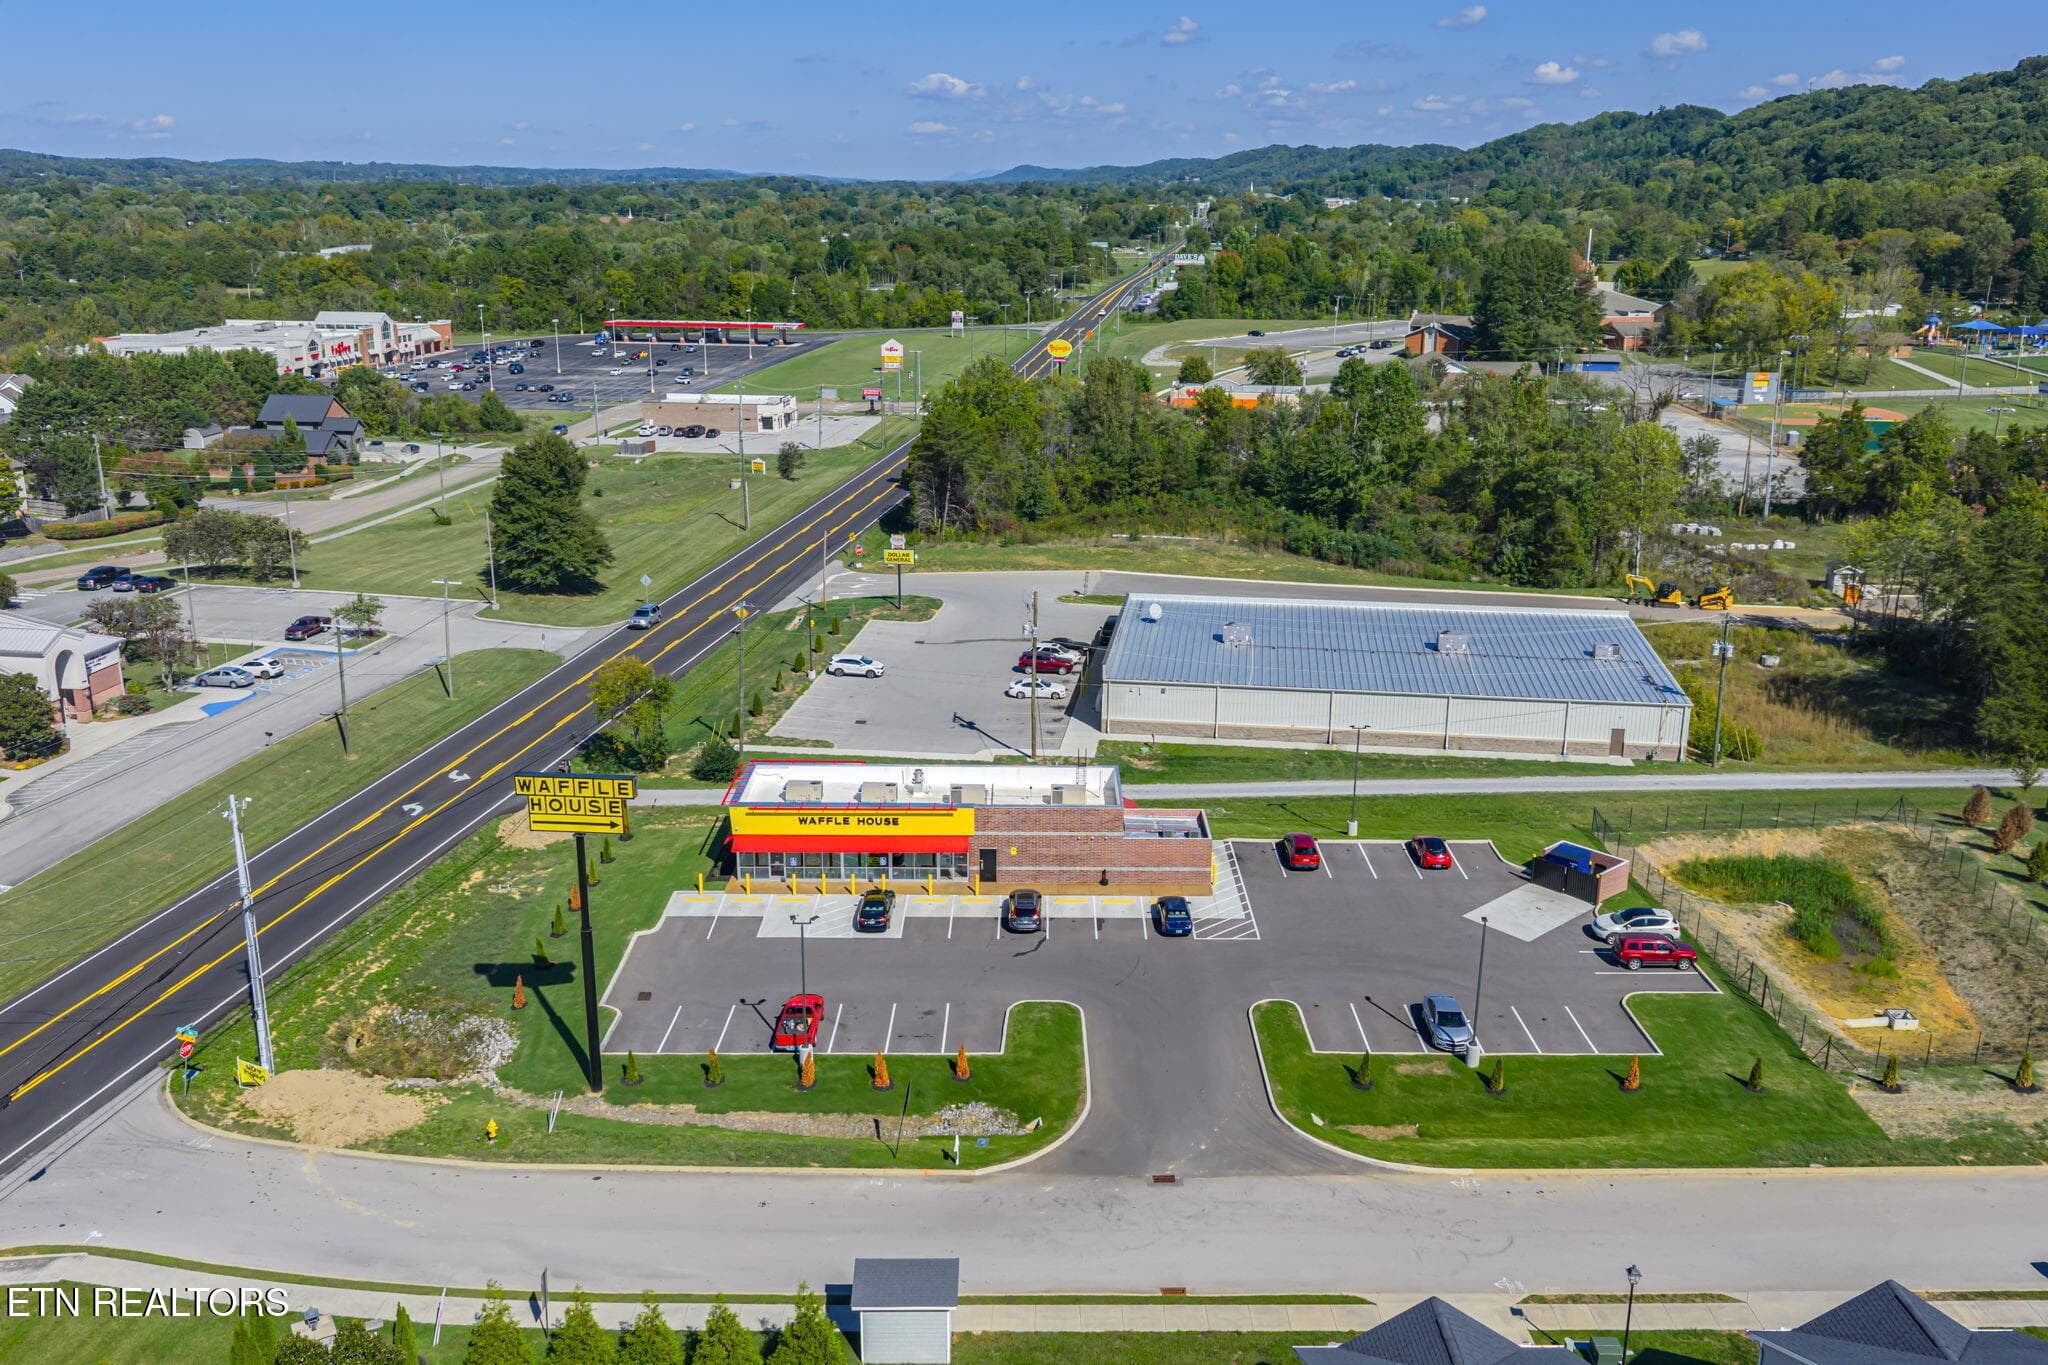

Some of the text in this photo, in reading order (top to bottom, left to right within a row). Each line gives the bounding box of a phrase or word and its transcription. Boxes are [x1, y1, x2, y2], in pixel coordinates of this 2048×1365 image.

[517, 779, 629, 796] WAFFLE
[530, 798, 621, 814] HOUSE
[798, 816, 899, 826] WAFFLE HOUSE
[180, 1043, 193, 1055] STOP
